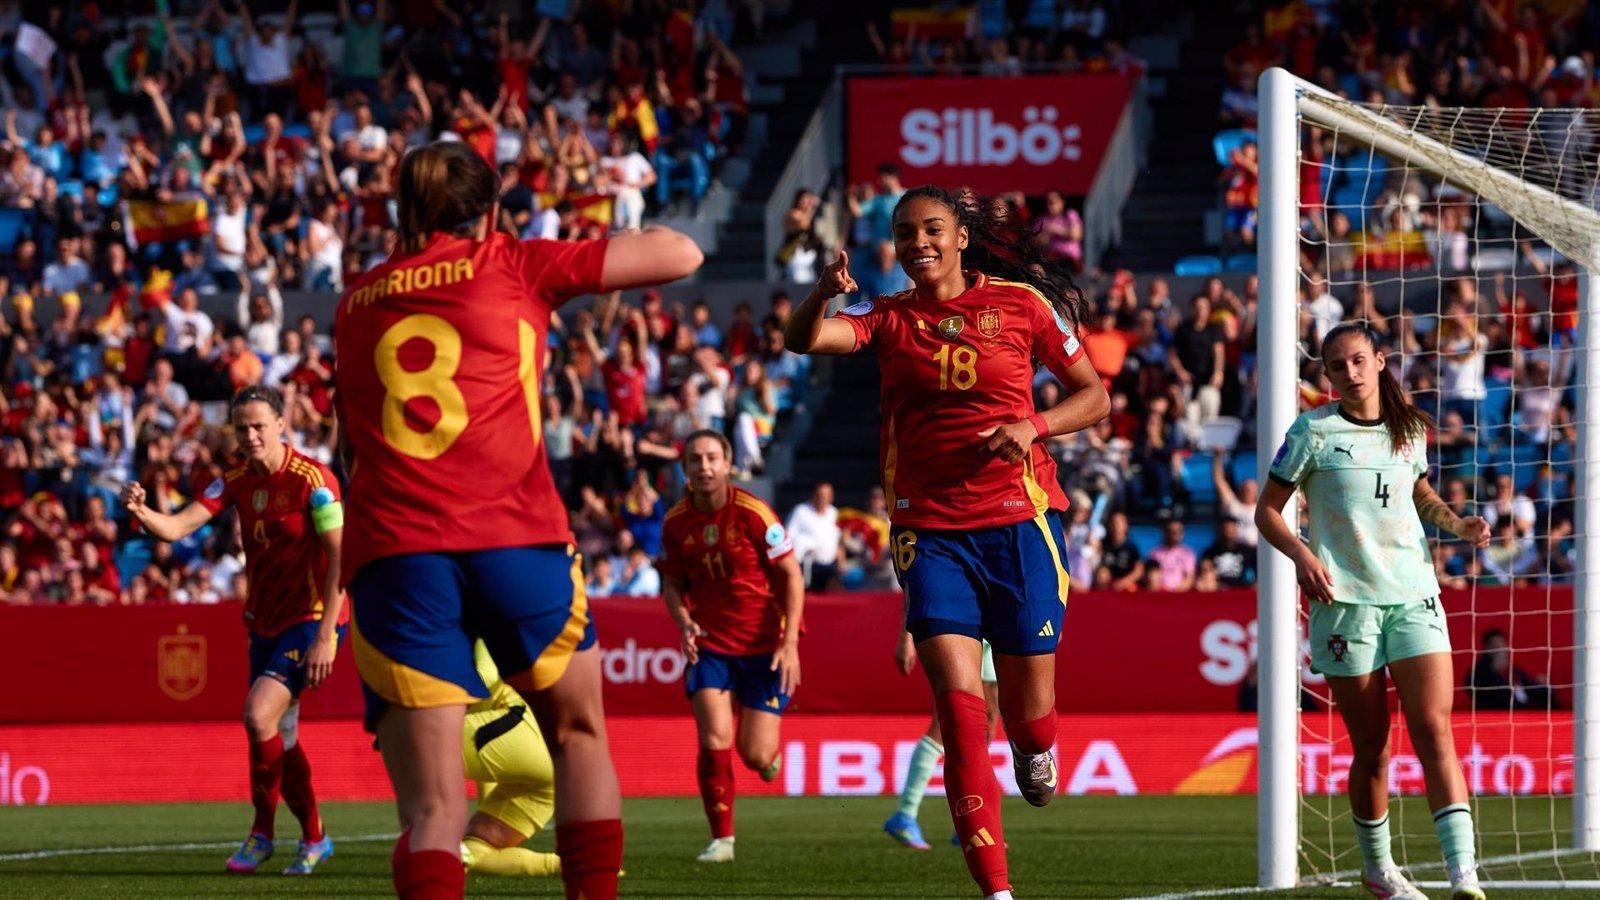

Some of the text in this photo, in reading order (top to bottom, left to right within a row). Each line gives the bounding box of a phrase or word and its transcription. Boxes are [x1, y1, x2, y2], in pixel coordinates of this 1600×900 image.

[900, 106, 1080, 167] Silbö:
[347, 257, 475, 314] MARIONA
[374, 313, 470, 460] 8
[933, 344, 978, 390] 18
[1374, 473, 1390, 508] 4
[253, 519, 270, 549] 4
[701, 551, 726, 579] 11
[1423, 596, 1438, 616] 4
[784, 741, 1140, 795] IBERA
[1298, 743, 1537, 795] Taeto
